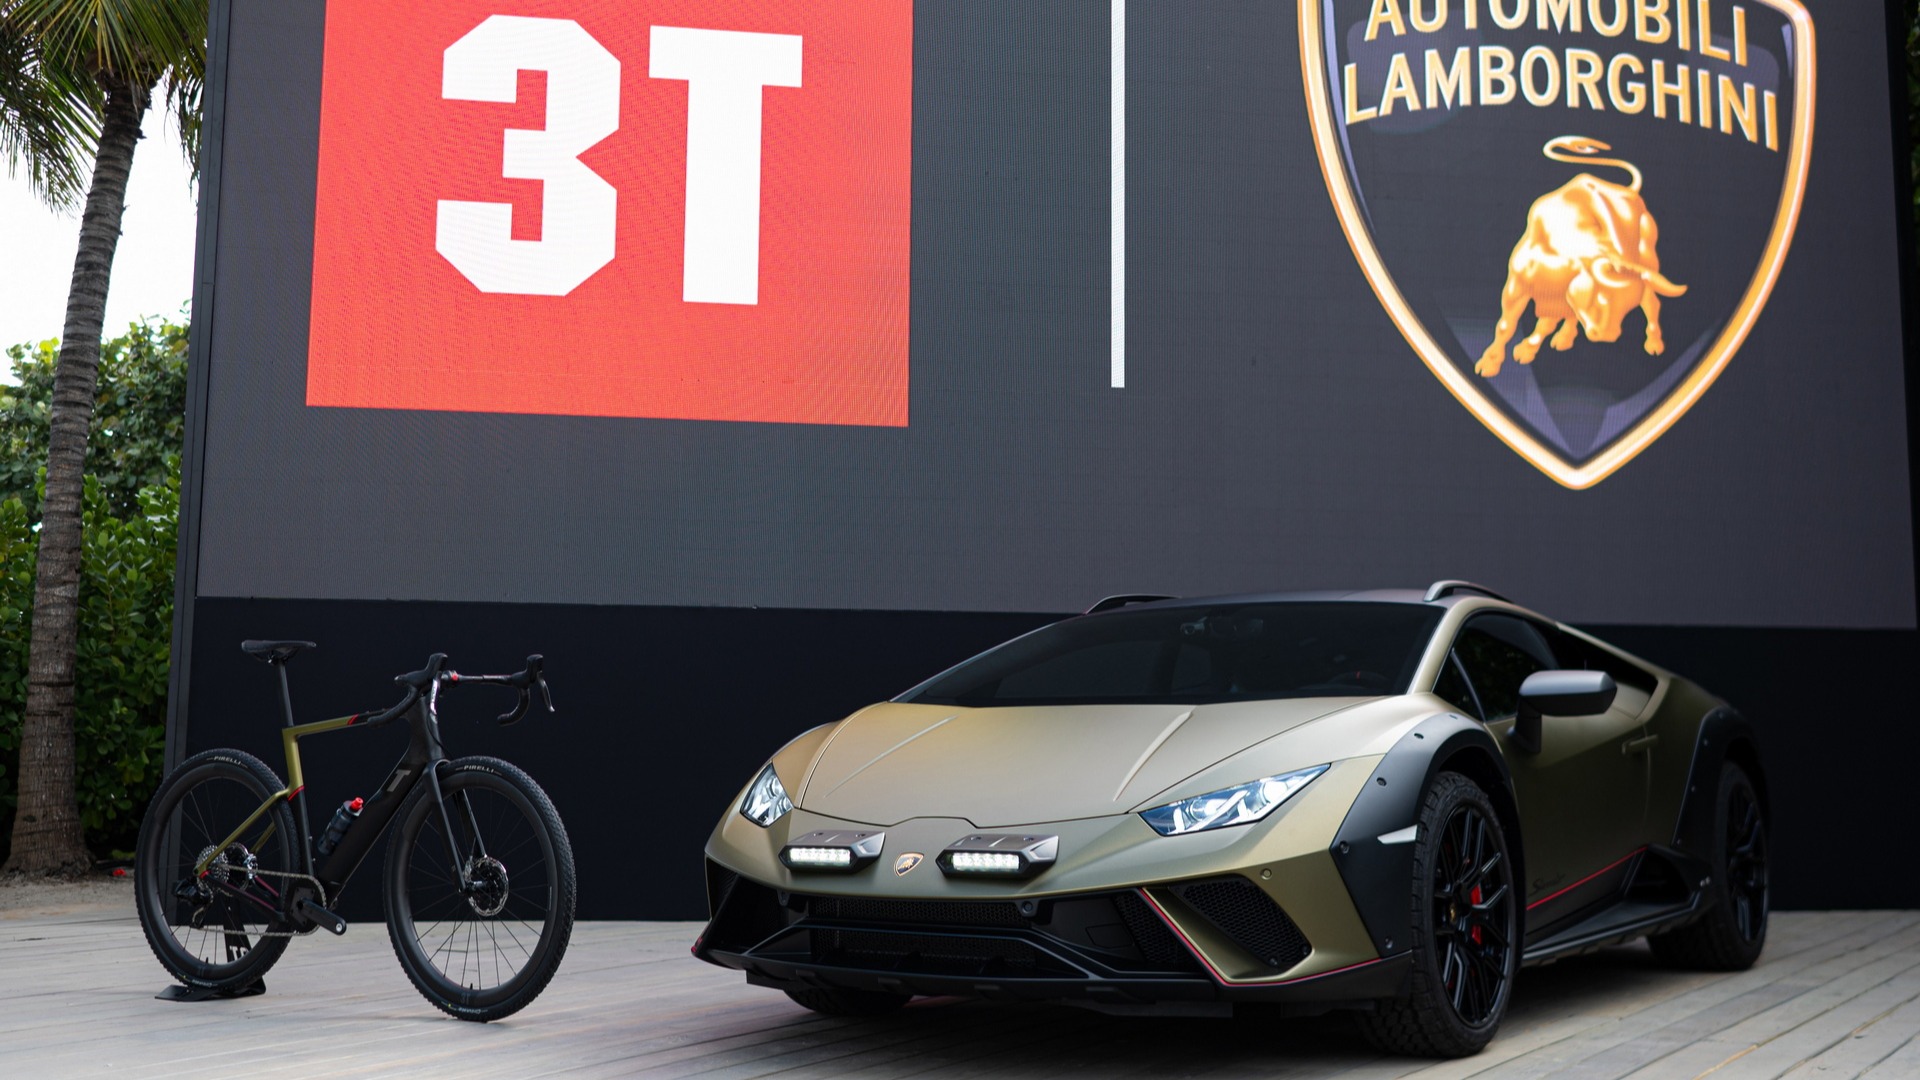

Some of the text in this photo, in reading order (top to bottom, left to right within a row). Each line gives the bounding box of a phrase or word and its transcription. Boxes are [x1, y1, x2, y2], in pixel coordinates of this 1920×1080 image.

[1344, 45, 1778, 152] LAMBORGHINI
[435, 14, 803, 306] 3T
[213, 755, 242, 766] PIRELLI
[463, 764, 495, 774] PIRELLI
